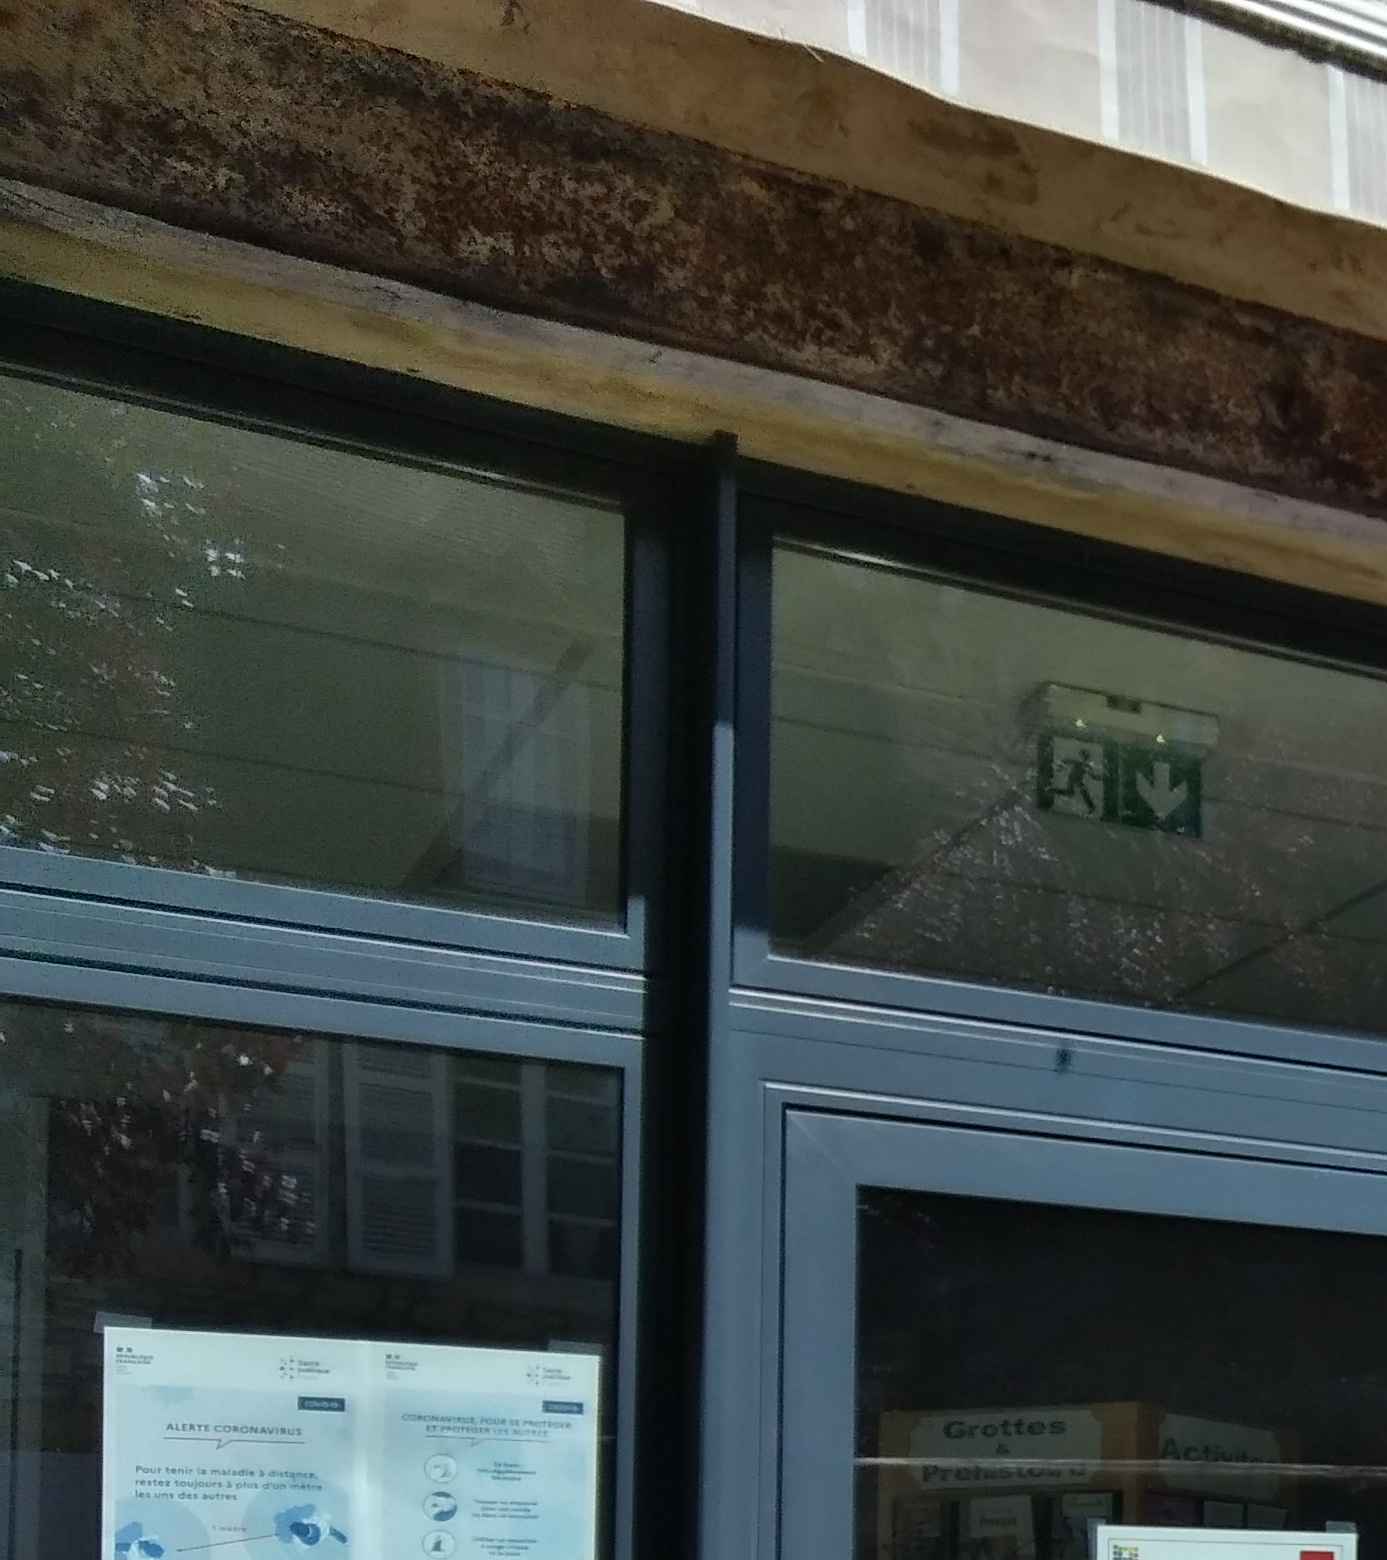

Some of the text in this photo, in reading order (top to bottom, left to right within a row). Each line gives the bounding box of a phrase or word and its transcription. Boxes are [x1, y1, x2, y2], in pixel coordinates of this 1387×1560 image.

[165, 1422, 303, 1437] ALERTE CORONAVIRUS
[942, 1416, 1068, 1440] Grottes
[135, 1465, 163, 1476] Pour
[164, 1466, 194, 1476] tenir
[210, 1467, 255, 1478] maladie
[135, 1478, 172, 1489] restez
[174, 1479, 223, 1491] toujours
[235, 1480, 259, 1493] plus
[135, 1490, 238, 1502] les uns des autres
